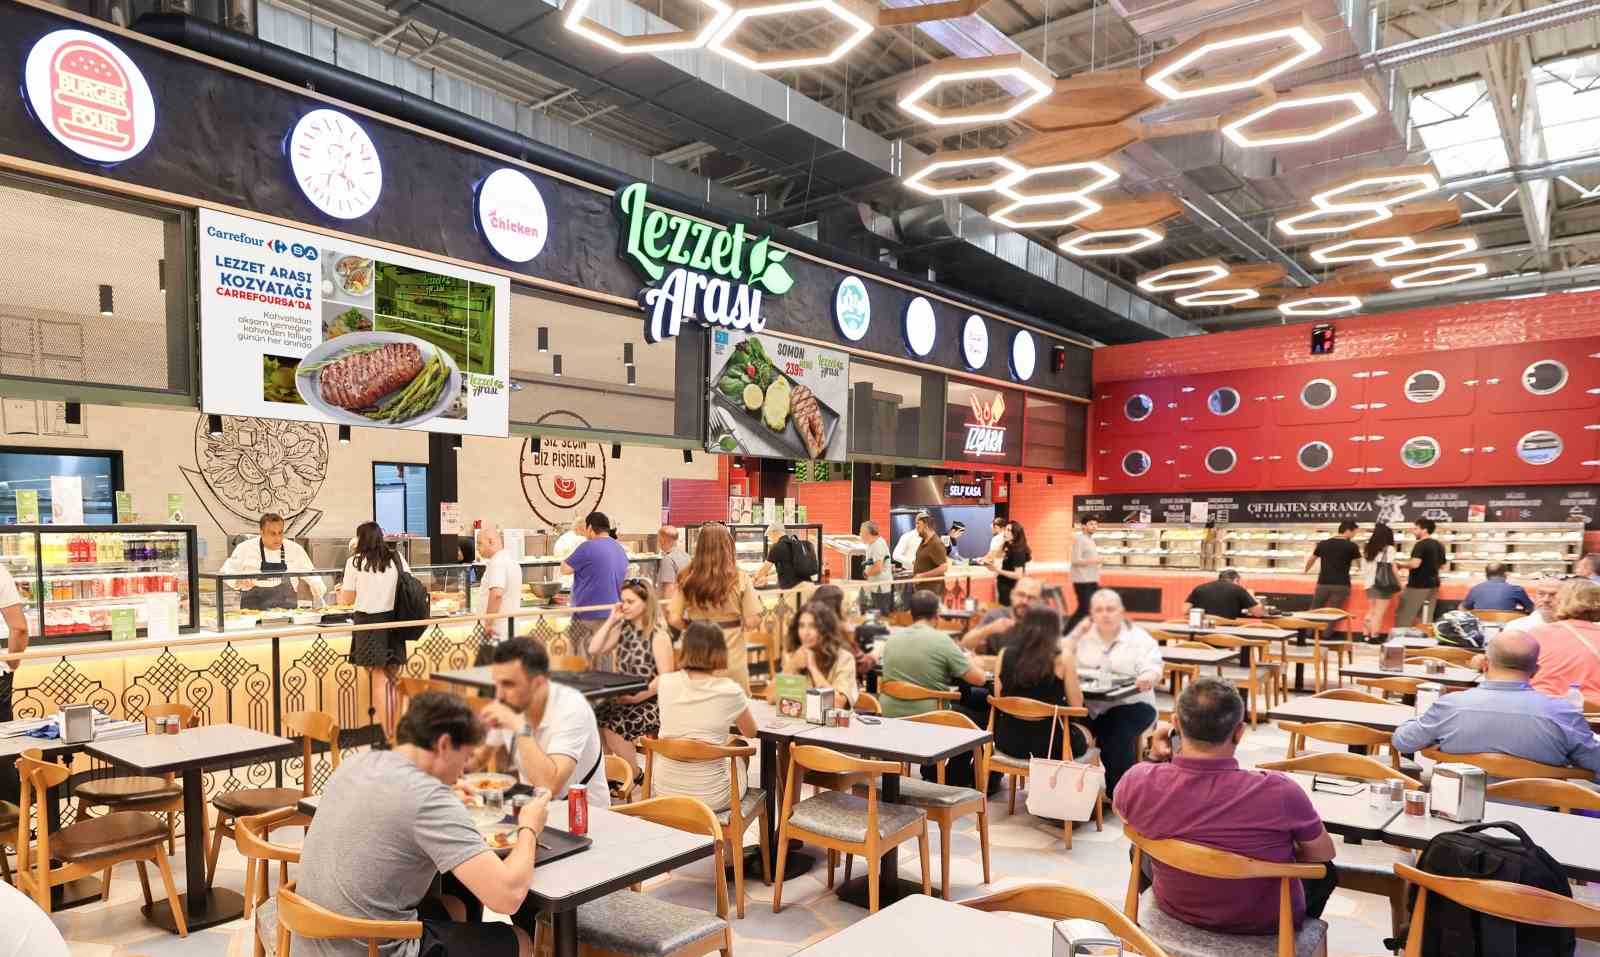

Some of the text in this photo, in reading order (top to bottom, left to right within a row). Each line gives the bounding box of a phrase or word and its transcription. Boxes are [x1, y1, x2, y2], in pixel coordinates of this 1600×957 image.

[58, 71, 128, 107] BURGER
[71, 107, 119, 133] FOUR
[207, 226, 264, 247] Carrefour
[621, 183, 746, 281] Lezzet
[215, 255, 312, 283] LEZZET ARASI
[220, 272, 312, 300] KOZYATAĞI
[216, 287, 312, 311] CARREFOURSA'DA
[646, 269, 766, 343] Arası
[777, 342, 805, 360] SOMON
[552, 450, 596, 469] PİŞİRELİM
[949, 485, 982, 497] SELF KASA
[1247, 502, 1307, 514] ÇİFTLİKTEN
[1309, 502, 1373, 513] SOFRANIZA
